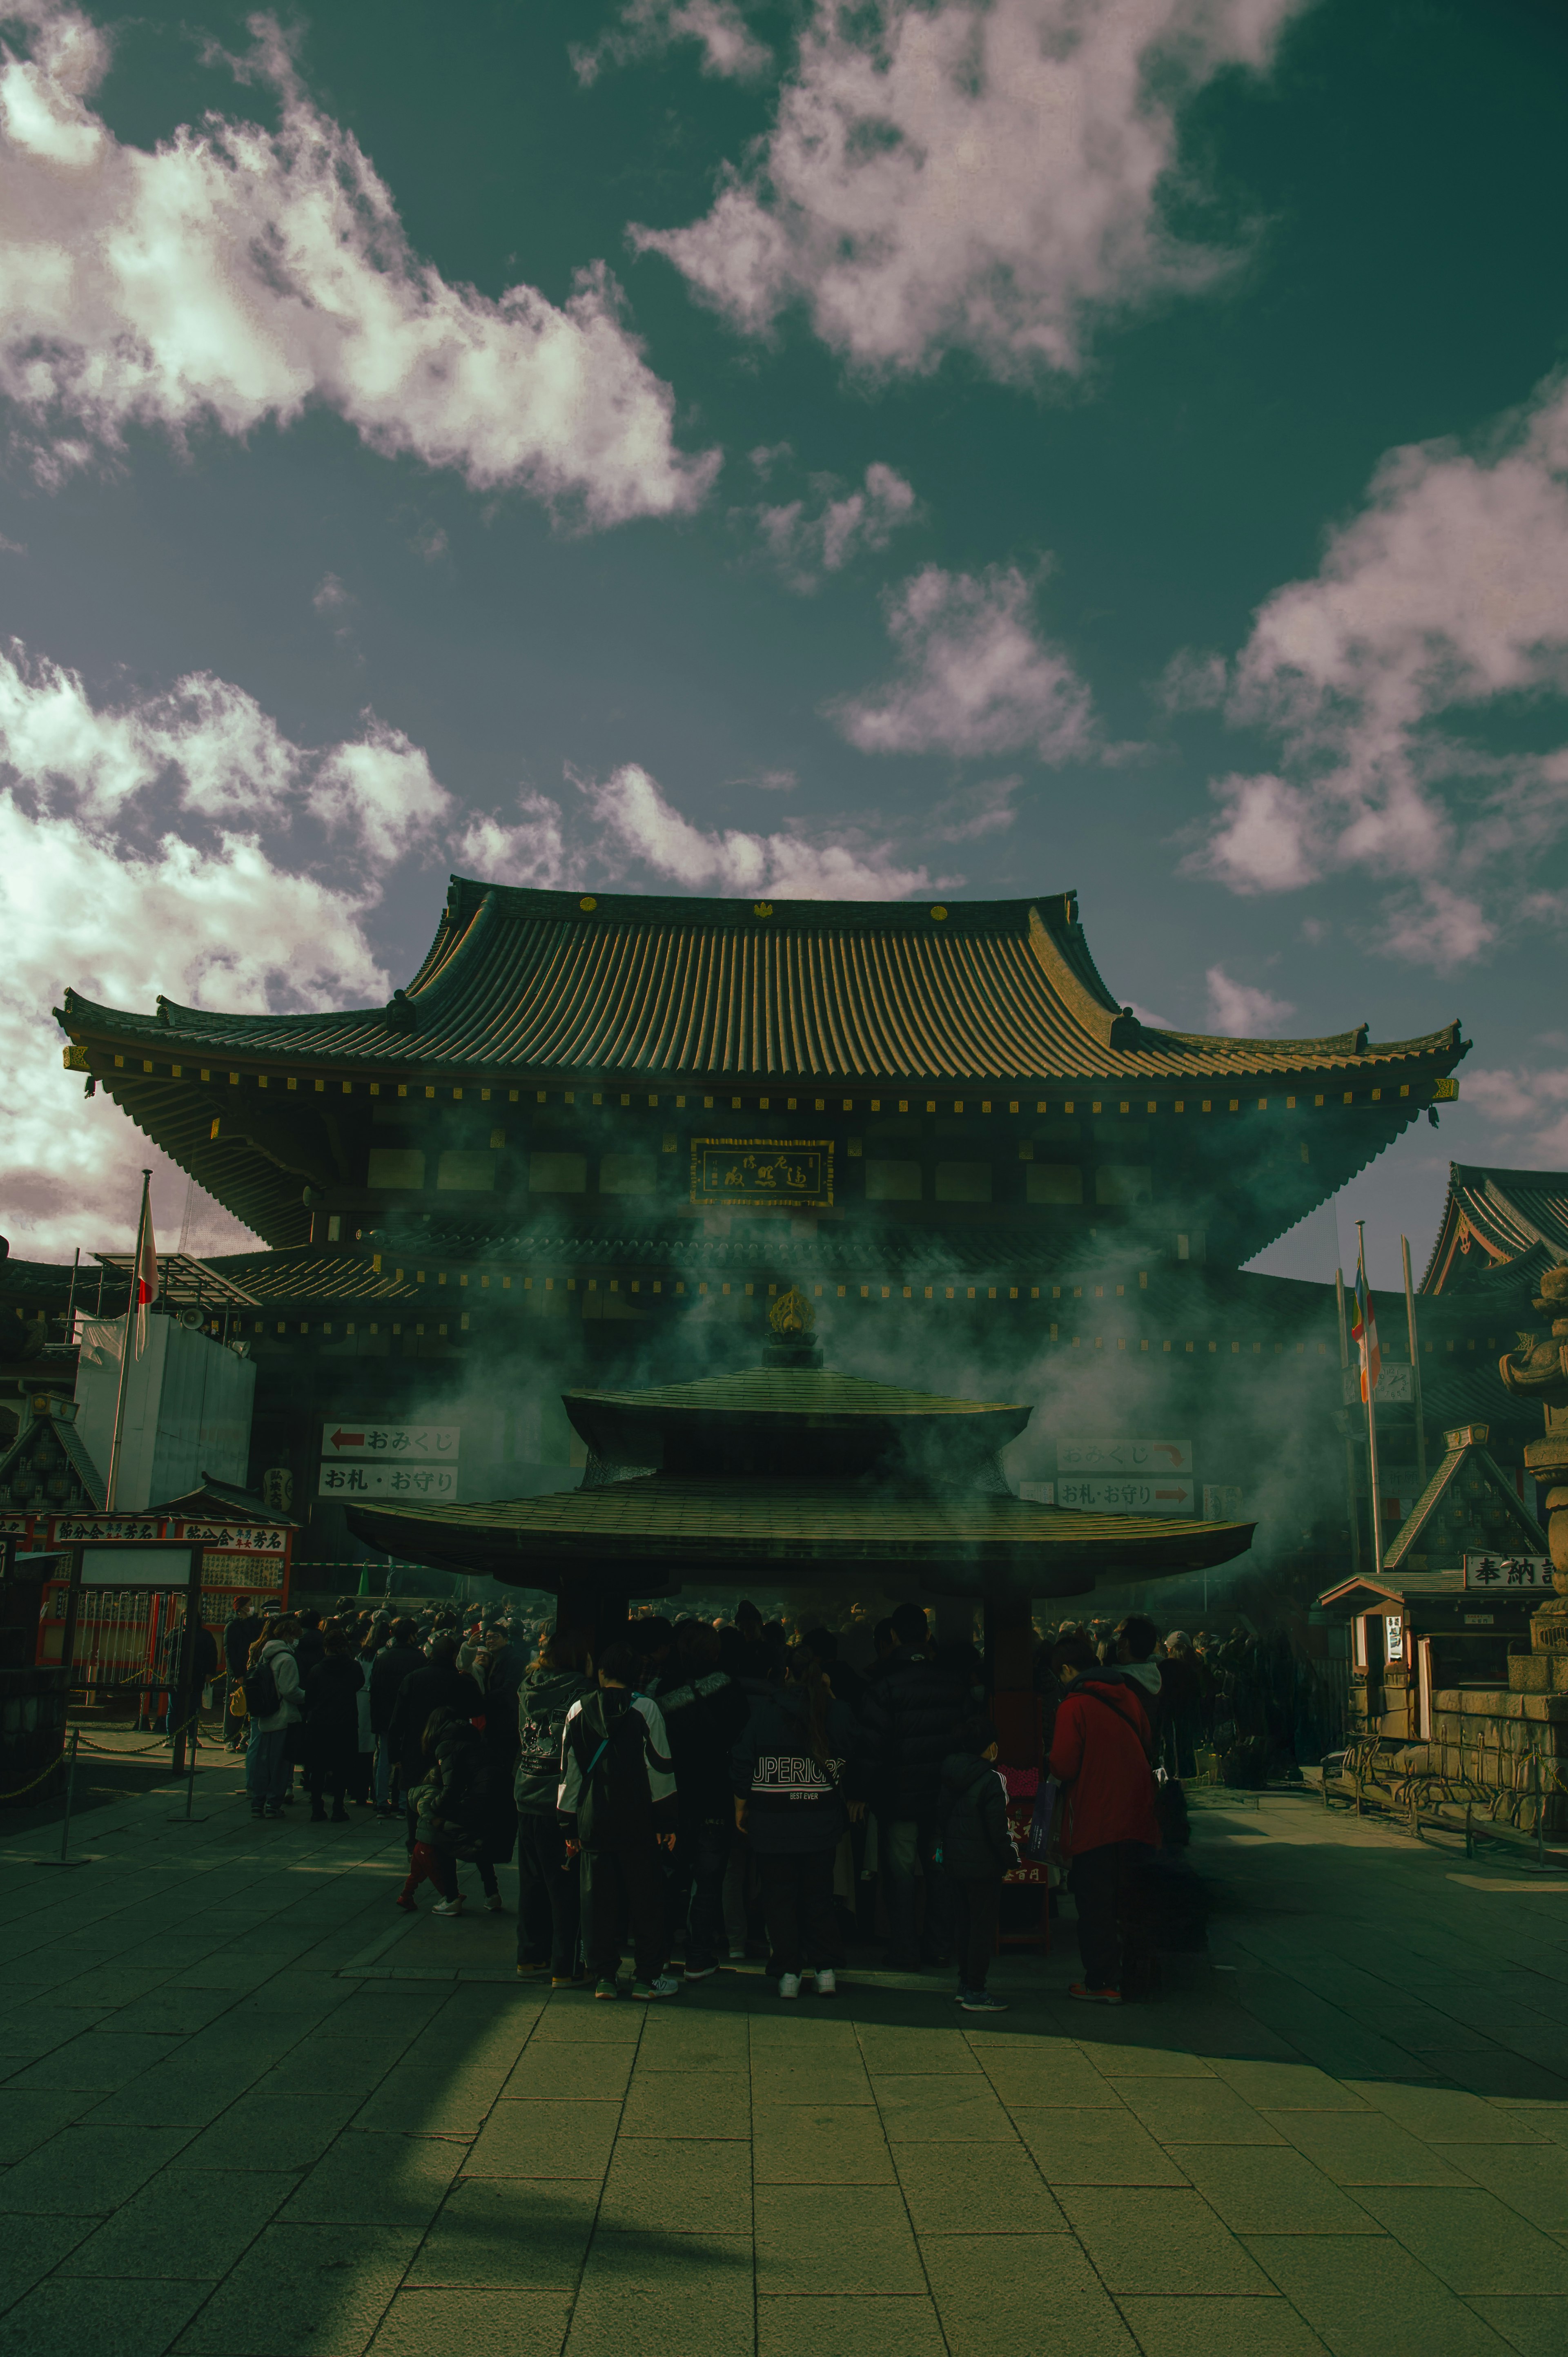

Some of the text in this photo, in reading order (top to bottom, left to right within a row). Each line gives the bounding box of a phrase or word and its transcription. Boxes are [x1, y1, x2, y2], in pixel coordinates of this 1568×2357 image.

[368, 1431, 452, 1451] おみくじ
[1062, 1445, 1148, 1464] おみくじ
[325, 1469, 452, 1492] お札・お守り
[1062, 1484, 1150, 1505] お札・お守り
[60, 1521, 105, 1539] 節分会
[124, 1523, 154, 1539] 芳名
[236, 1528, 252, 1540] 年男
[254, 1530, 282, 1549] 芳名
[235, 1539, 252, 1548] 年女
